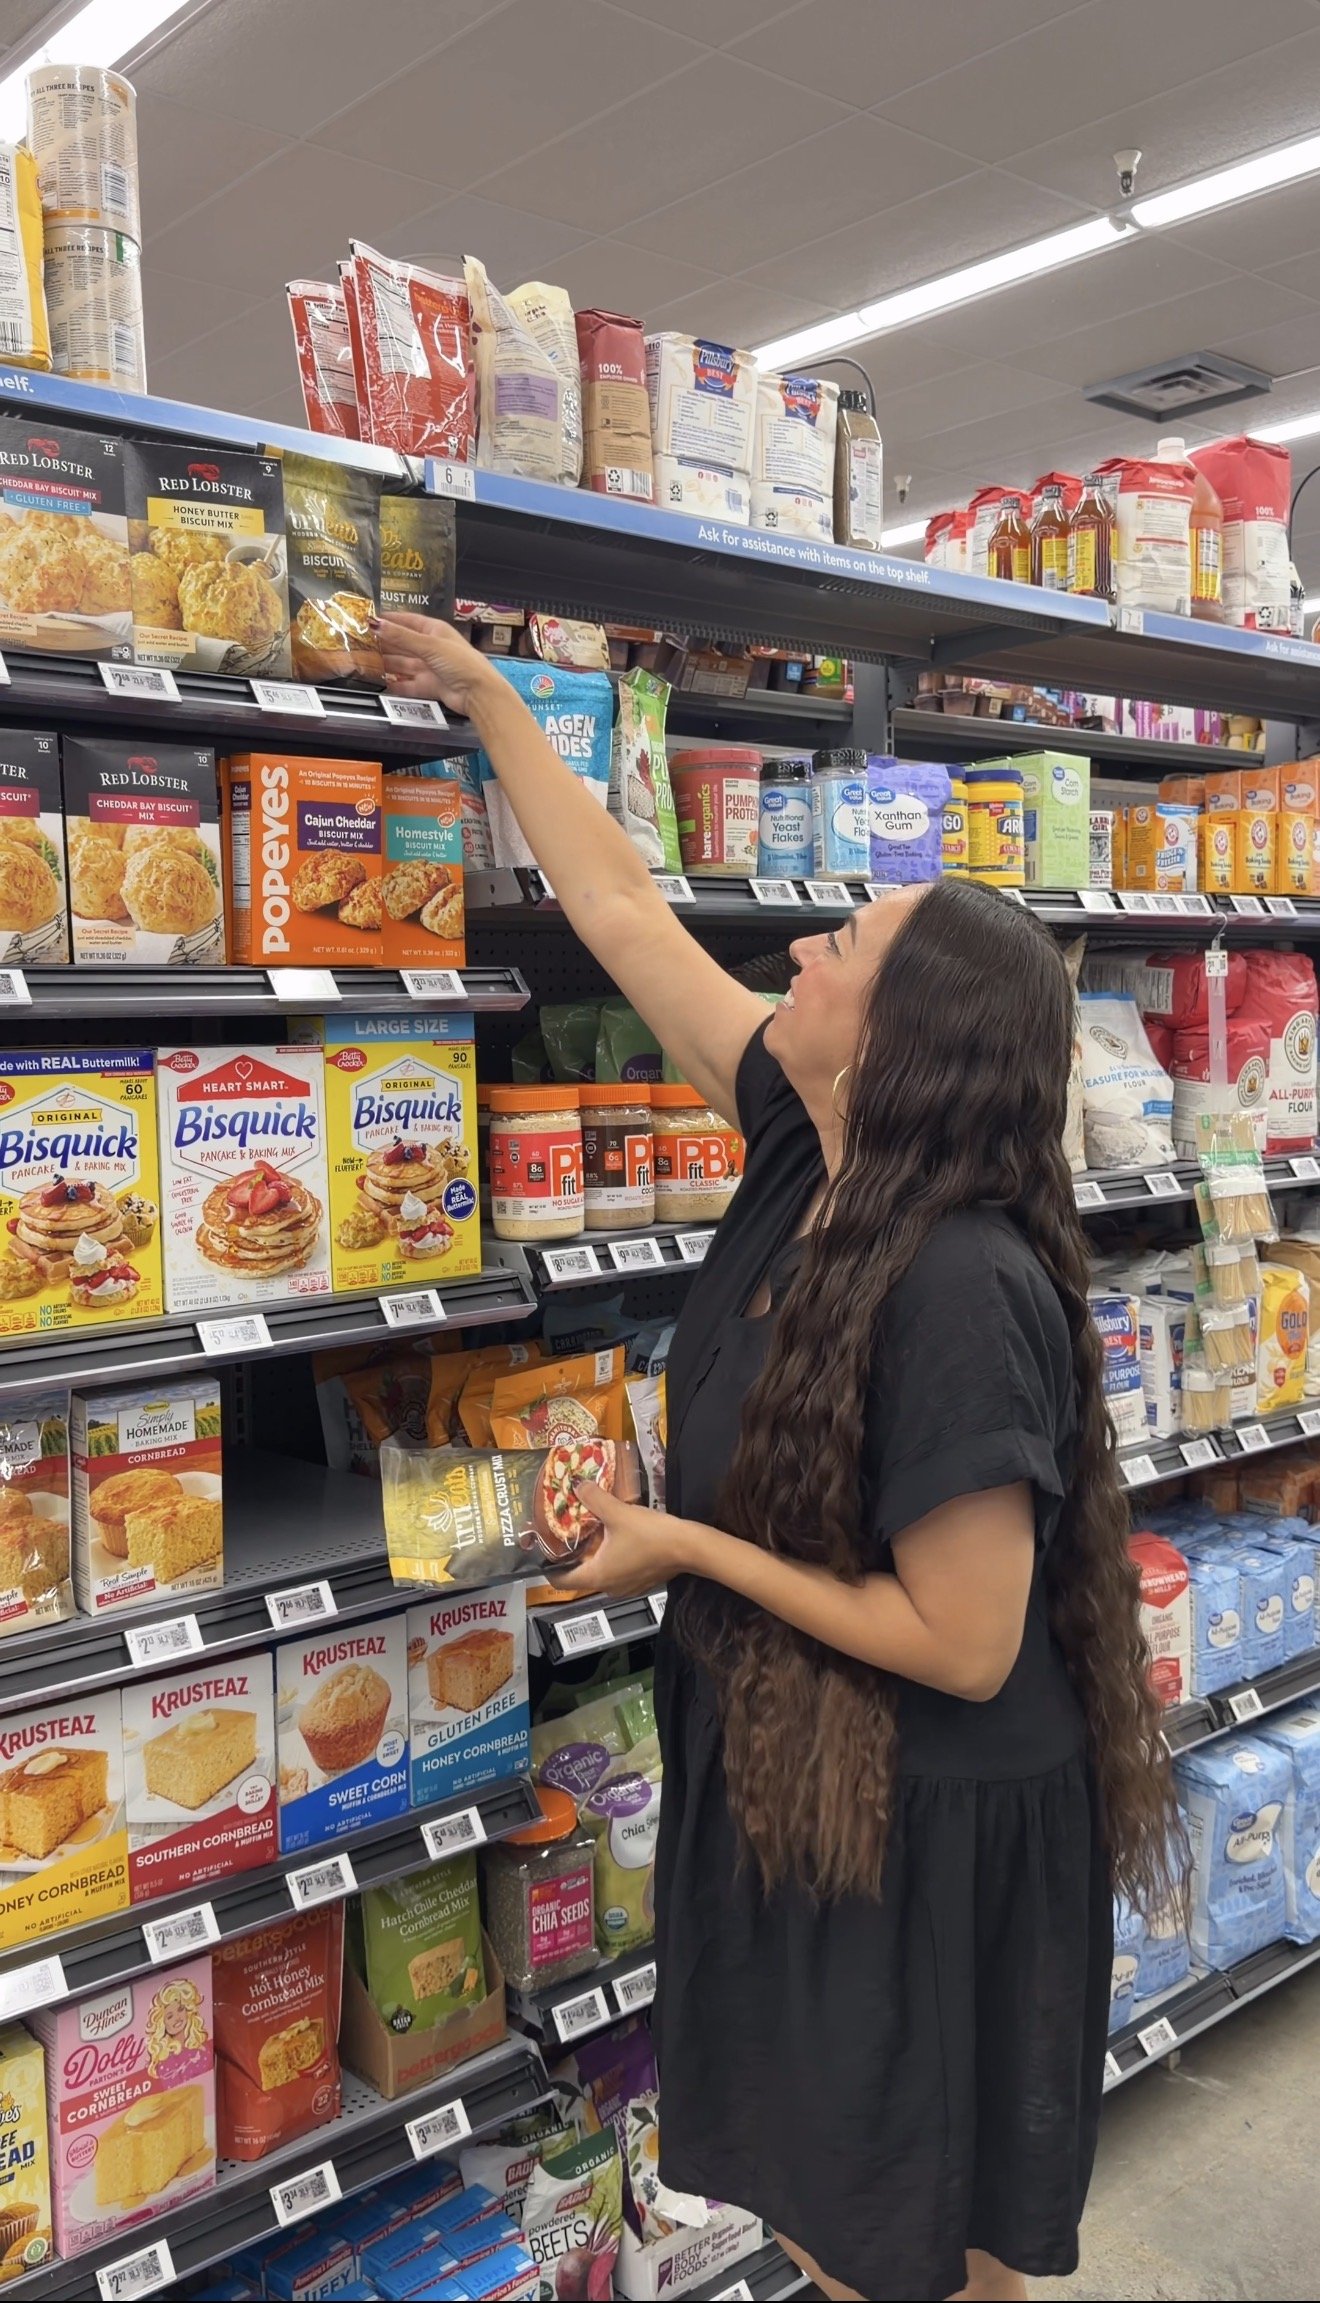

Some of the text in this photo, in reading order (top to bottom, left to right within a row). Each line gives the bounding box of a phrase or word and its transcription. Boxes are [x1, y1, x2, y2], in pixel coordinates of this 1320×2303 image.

[700, 349, 734, 373] Pillsbury
[706, 368, 724, 380] BEST
[787, 381, 817, 402] Pillsbury
[0, 452, 93, 480] RED LOBSTER
[445, 468, 453, 484] 6
[159, 477, 252, 500] RED LOBSTER
[16, 494, 80, 512] GLUTEN FREE
[173, 506, 239, 520] HONEY BUTTER
[180, 517, 234, 528] BISCUIT MIX
[698, 525, 931, 585] Ask for assistance with items on the top shelf.
[39, 741, 49, 750] 10
[100, 771, 188, 791] RED LOBSTER
[764, 795, 782, 805] Great
[844, 788, 864, 797] Great
[870, 790, 891, 800] Great
[1061, 787, 1079, 797] Starch
[96, 800, 190, 812] CHEDDAR BAY BISCUIT
[138, 811, 155, 821] MIX
[304, 814, 376, 830] Cajun Cheddar
[875, 811, 922, 821] Xanthan
[318, 830, 364, 840] BISCUIT MIX
[396, 826, 454, 841] Homestyle
[773, 823, 800, 833] Yeast
[885, 821, 913, 831] Gum
[405, 841, 446, 850] BISCUIT MIX
[772, 833, 804, 843] Flakes
[355, 1019, 449, 1035] LARGE SIZE
[0, 1056, 140, 1071] de with REAL Buttermilk!
[453, 1052, 467, 1063] 90
[125, 1084, 143, 1095] 60
[203, 1081, 285, 1093] HEART SMART
[385, 1081, 431, 1089] ORIGINAL
[1124, 1080, 1147, 1089] FLOUR
[354, 1092, 462, 1129] Bisquick
[1288, 1101, 1313, 1114] FLOUR
[37, 1114, 98, 1122] ORIGINAL
[175, 1102, 316, 1148] Bisquick
[0, 1124, 138, 1170] Bisquick
[200, 1146, 295, 1162] PANCAKE & BAKING MIX
[677, 1137, 728, 1180] PB
[637, 1166, 651, 1186] fit
[688, 1164, 704, 1180] fit
[561, 1176, 577, 1196] fit
[689, 1179, 720, 1188] CLASSIC
[451, 1194, 468, 1204] REAL
[552, 1198, 581, 1207] NO SUGAR
[40, 1305, 52, 1315] NO
[40, 1317, 52, 1327] NO
[1281, 1311, 1307, 1329] GOLD
[1109, 1365, 1140, 1383] PURPOSE
[137, 1410, 174, 1429] Simply
[126, 1420, 188, 1440] HOMEMADE
[135, 1435, 178, 1448] BAKING MIX
[128, 1447, 186, 1465] CORNBREAD
[491, 1454, 515, 1546] PIZZA CRUST MIX
[430, 1600, 507, 1636] KRUSTEAZ
[1151, 1612, 1173, 1623] ORGANIC
[1155, 1627, 1180, 1642] PURPOSE
[303, 1636, 386, 1676] KRUSTEAZ
[1153, 1641, 1171, 1655] FLOUR
[152, 1677, 248, 1719] KRUSTEAZ
[427, 1692, 516, 1748] GLUTEN FREE
[0, 1714, 96, 1760] KRUSTEAZ
[422, 1750, 461, 1773] HONEY
[463, 1730, 528, 1760] CORNBREAD
[546, 1749, 604, 1781] Organic
[329, 1770, 407, 1807] SWEET CORN
[341, 1800, 360, 1811] MUFFIN
[367, 1788, 396, 1802] CORNBREAD
[397, 1783, 407, 1793] MIX
[325, 1811, 372, 1831] NO ARTIFICIAL
[621, 1820, 646, 1841] Chia
[136, 1819, 273, 1867] SOUTHERN CORNBREAD
[179, 1860, 234, 1880] NO ARTIFICIAL
[38, 1865, 125, 1901] CORNBREAD
[91, 1882, 113, 1896] MUFFIN
[115, 1877, 125, 1888] MIX
[380, 1876, 478, 1930] Hatch Chile Cheddar
[532, 1899, 561, 1917] ORGANIC
[25, 1908, 83, 1931] NO ARTIFICIAL
[399, 1897, 470, 1937] Cornbread Mix
[532, 1899, 590, 1935] CHIA SEEDS
[249, 1965, 311, 1998] Hot Honey
[241, 1974, 325, 2016] Cornbread Mix
[83, 1998, 128, 2029] Duncan
[90, 2009, 126, 2037] Hines
[64, 2034, 145, 2090] Dolly
[89, 2068, 124, 2087] PARTON'S
[93, 2081, 127, 2102] SWEET
[67, 2081, 151, 2123] CORNBREAD
[21, 2159, 35, 2170] MIX
[575, 2146, 616, 2176] ORGANIC
[557, 2186, 592, 2212] BADIA
[528, 2207, 577, 2237] powdered
[529, 2219, 589, 2264] BEETS
[710, 2218, 758, 2252] Superfood Blend
[674, 2235, 711, 2264] BETTER
[673, 2257, 710, 2284] FOODS
[674, 2252, 700, 2275] BODY
